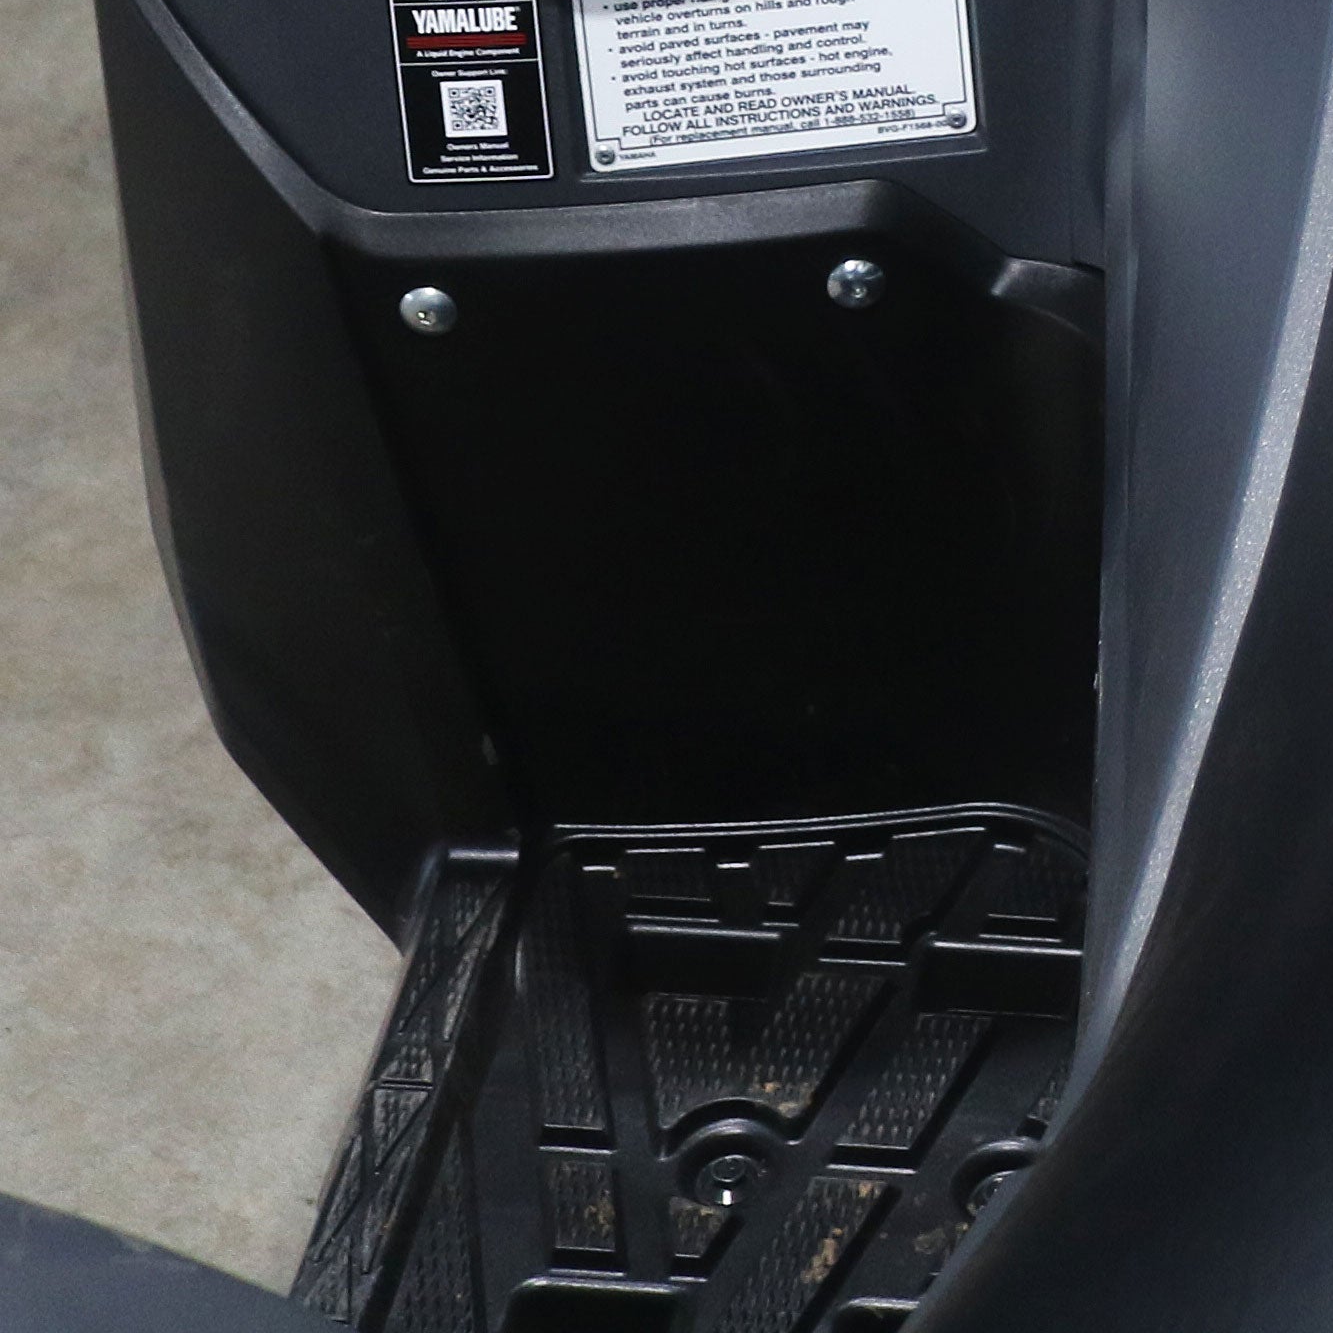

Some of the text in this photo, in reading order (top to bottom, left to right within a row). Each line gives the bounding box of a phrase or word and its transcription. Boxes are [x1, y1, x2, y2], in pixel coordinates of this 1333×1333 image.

[613, 1, 637, 11] use
[615, 13, 662, 24] vehicle
[667, 7, 730, 20] overturns
[734, 4, 751, 13] on
[755, 0, 782, 10] hills
[412, 7, 518, 34] YAMALUBE
[616, 19, 746, 39] terrain and in turns.
[619, 21, 868, 53] avoid paved surfaces pavement may
[621, 34, 864, 67] seriously affect handling and control.
[622, 47, 891, 82] avoid touching hot surfaces hot engine,
[623, 62, 880, 96] exhaust system and those surrounding
[625, 88, 775, 111] parts can cause burns.
[643, 106, 699, 121] LOCATE
[703, 103, 733, 115] AND
[737, 98, 776, 111] READ
[780, 91, 847, 107] OWNER'S
[622, 94, 938, 136] FOLLOW ALL INSTRUCTIONS AND WARNINGS.
[675, 127, 747, 141] replacement
[800, 118, 820, 129] call
